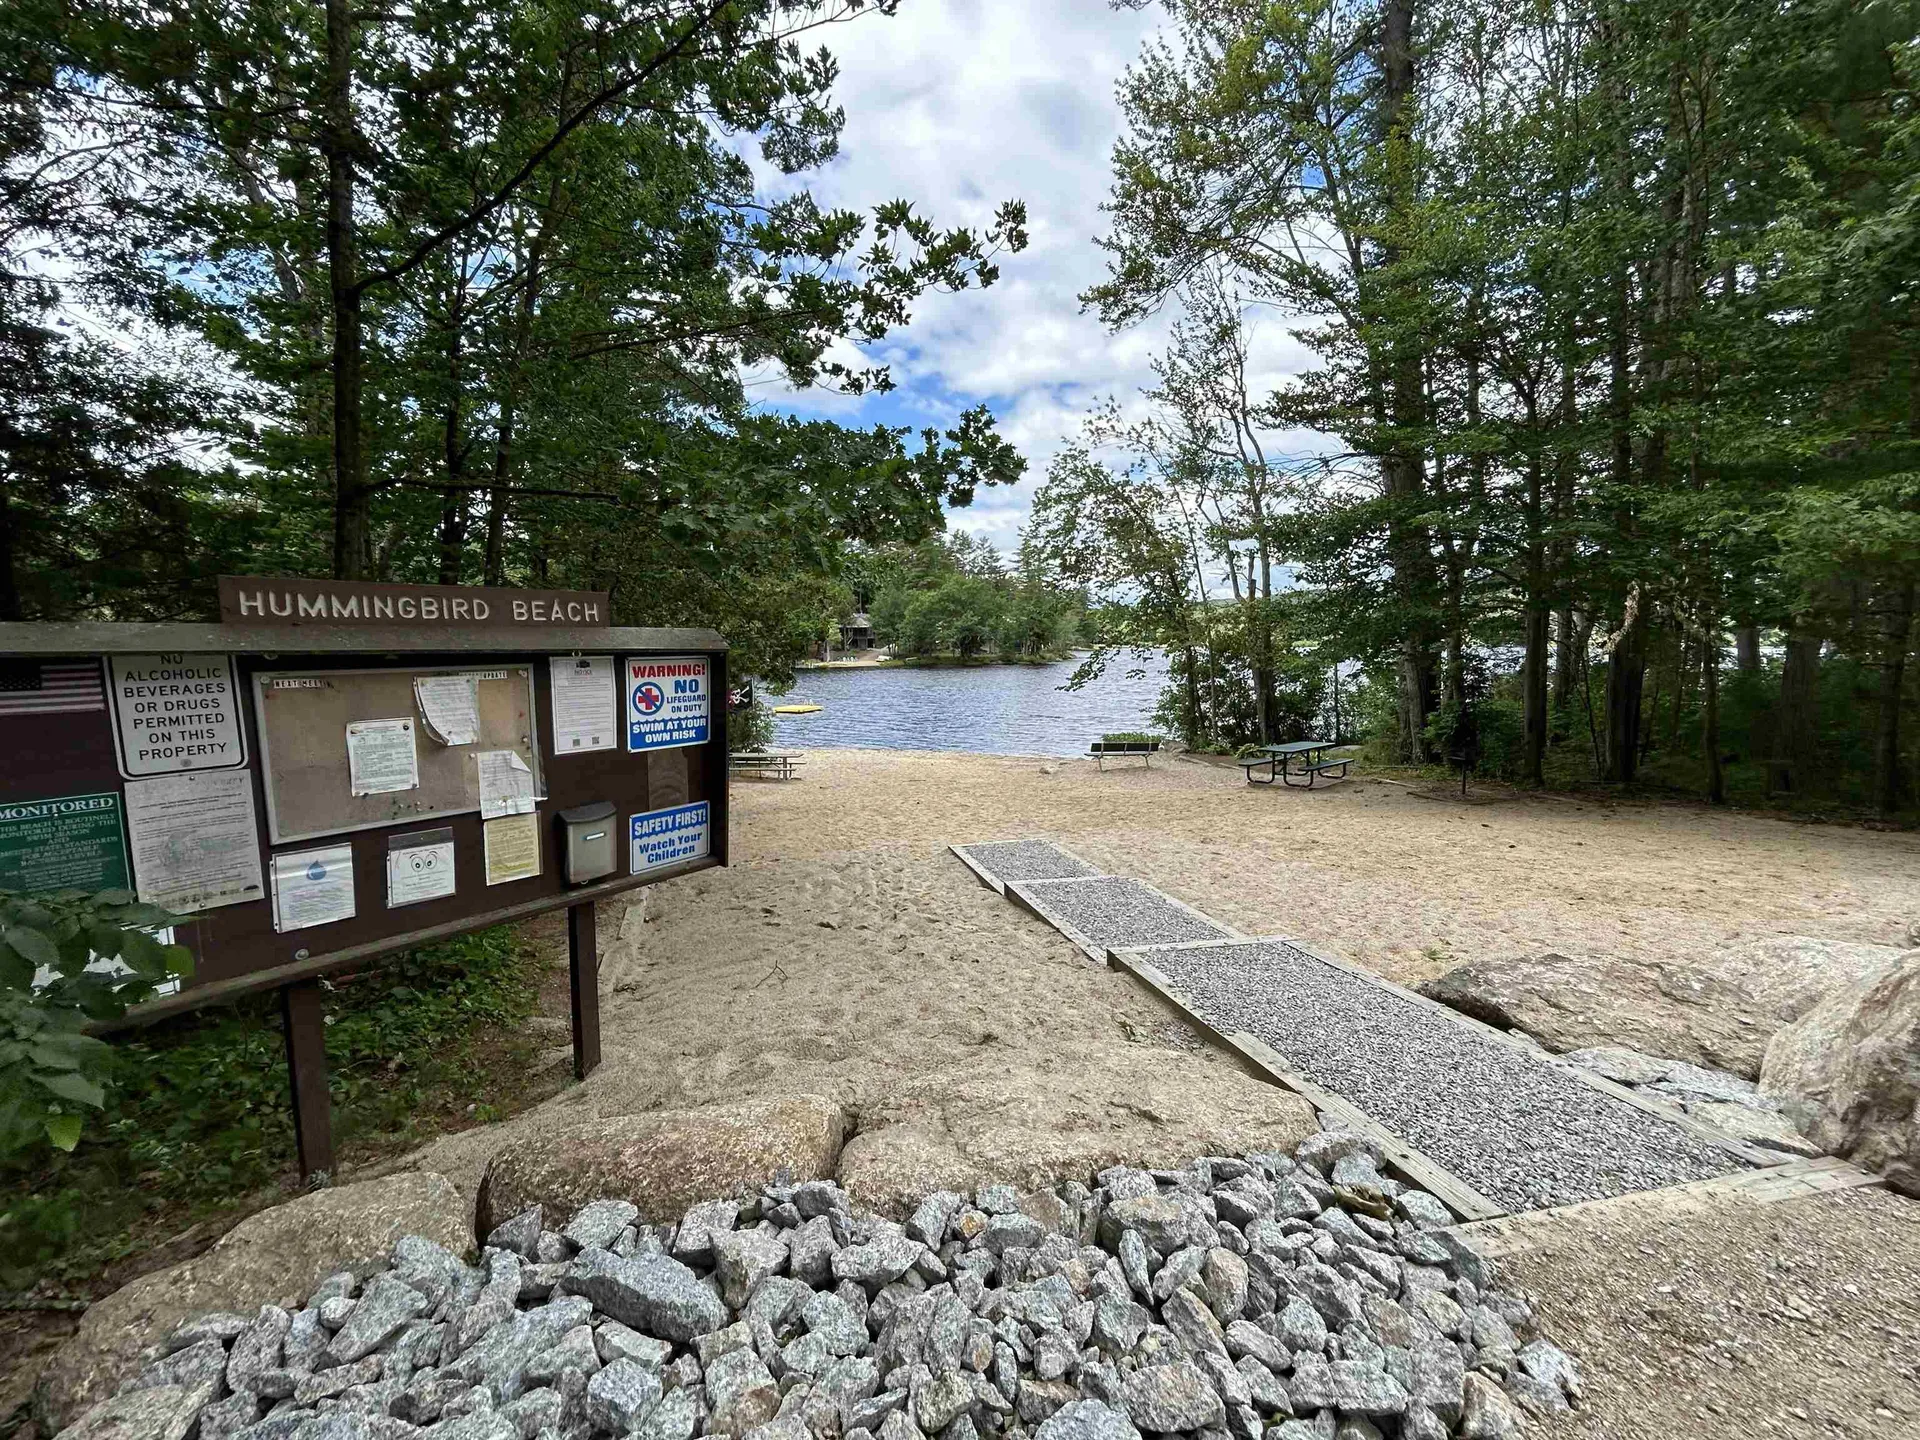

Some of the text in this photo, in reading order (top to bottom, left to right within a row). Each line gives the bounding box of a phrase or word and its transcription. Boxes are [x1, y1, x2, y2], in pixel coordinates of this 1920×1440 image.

[238, 589, 600, 623] HUMMINGBIRD BEACH
[160, 652, 184, 665] NO
[125, 667, 222, 682] ALCOHOLIC
[632, 663, 706, 678] WARNING!
[124, 682, 226, 698] BEVERAGES
[674, 678, 699, 694] NO
[134, 698, 221, 713] OR DRUGS
[666, 694, 706, 704] LIFEGUARD
[671, 703, 702, 713] ON DUTY
[133, 712, 225, 729] PERMITTED
[632, 717, 706, 734] SWIM AT YOUR
[148, 728, 216, 744] ON THIS
[645, 728, 696, 743] OWN RISK
[139, 742, 227, 760] PROPERTY
[0, 797, 113, 819] MONITORED
[20, 820, 52, 831] BEACH
[64, 813, 116, 825] ROUTINELY
[634, 808, 706, 836] SAFETY FIRST!
[639, 832, 702, 854] Watch Your
[647, 845, 695, 863] Children
